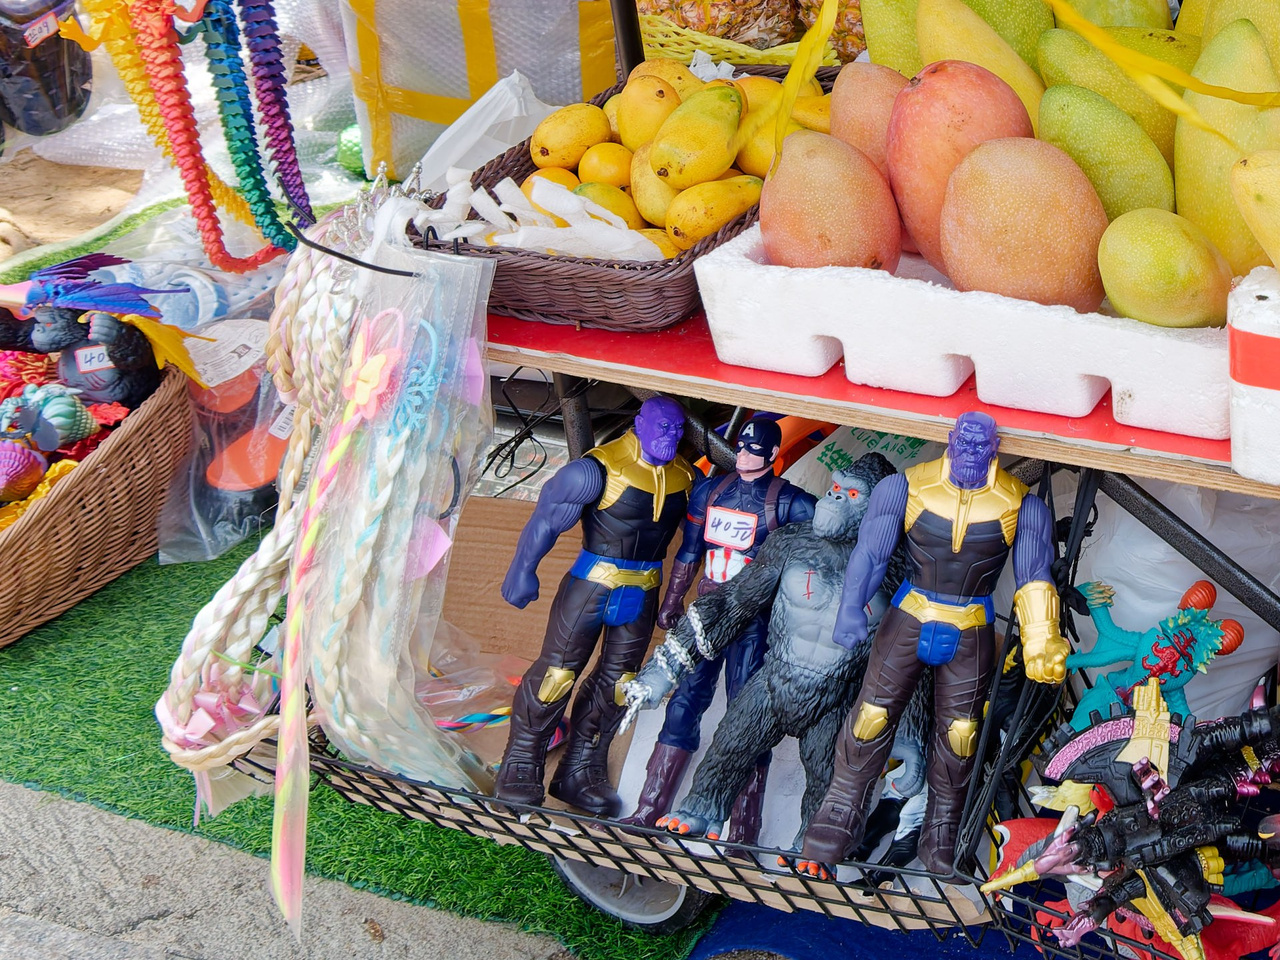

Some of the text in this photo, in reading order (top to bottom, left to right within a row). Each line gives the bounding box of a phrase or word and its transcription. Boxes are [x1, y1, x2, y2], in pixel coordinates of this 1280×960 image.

[84, 351, 110, 367] 40
[741, 422, 755, 438] A
[710, 515, 755, 542] 40元
